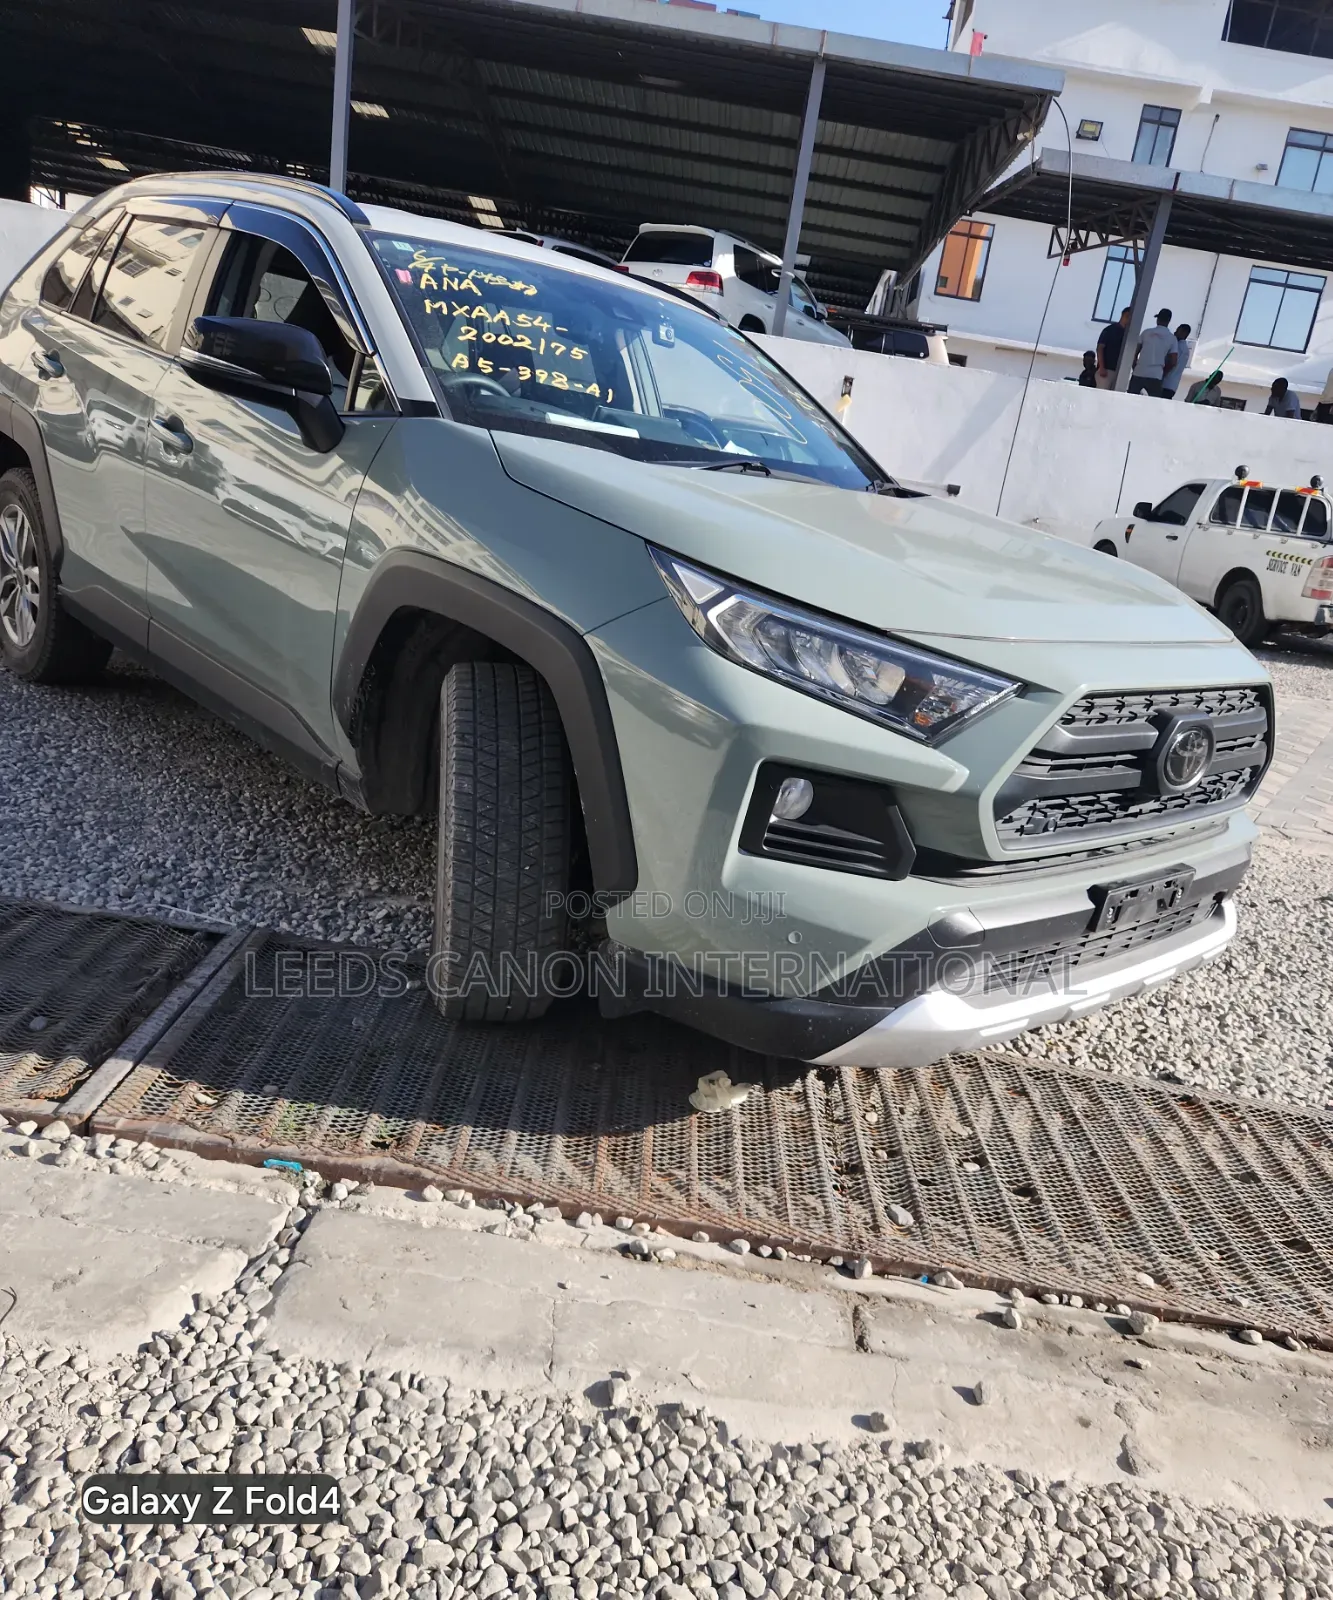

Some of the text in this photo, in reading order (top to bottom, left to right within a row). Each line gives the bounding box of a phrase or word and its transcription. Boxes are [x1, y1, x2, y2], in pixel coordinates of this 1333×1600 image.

[420, 273, 482, 296] ANA
[457, 325, 589, 361] 2002175
[1266, 558, 1303, 577] SERVICE VAN
